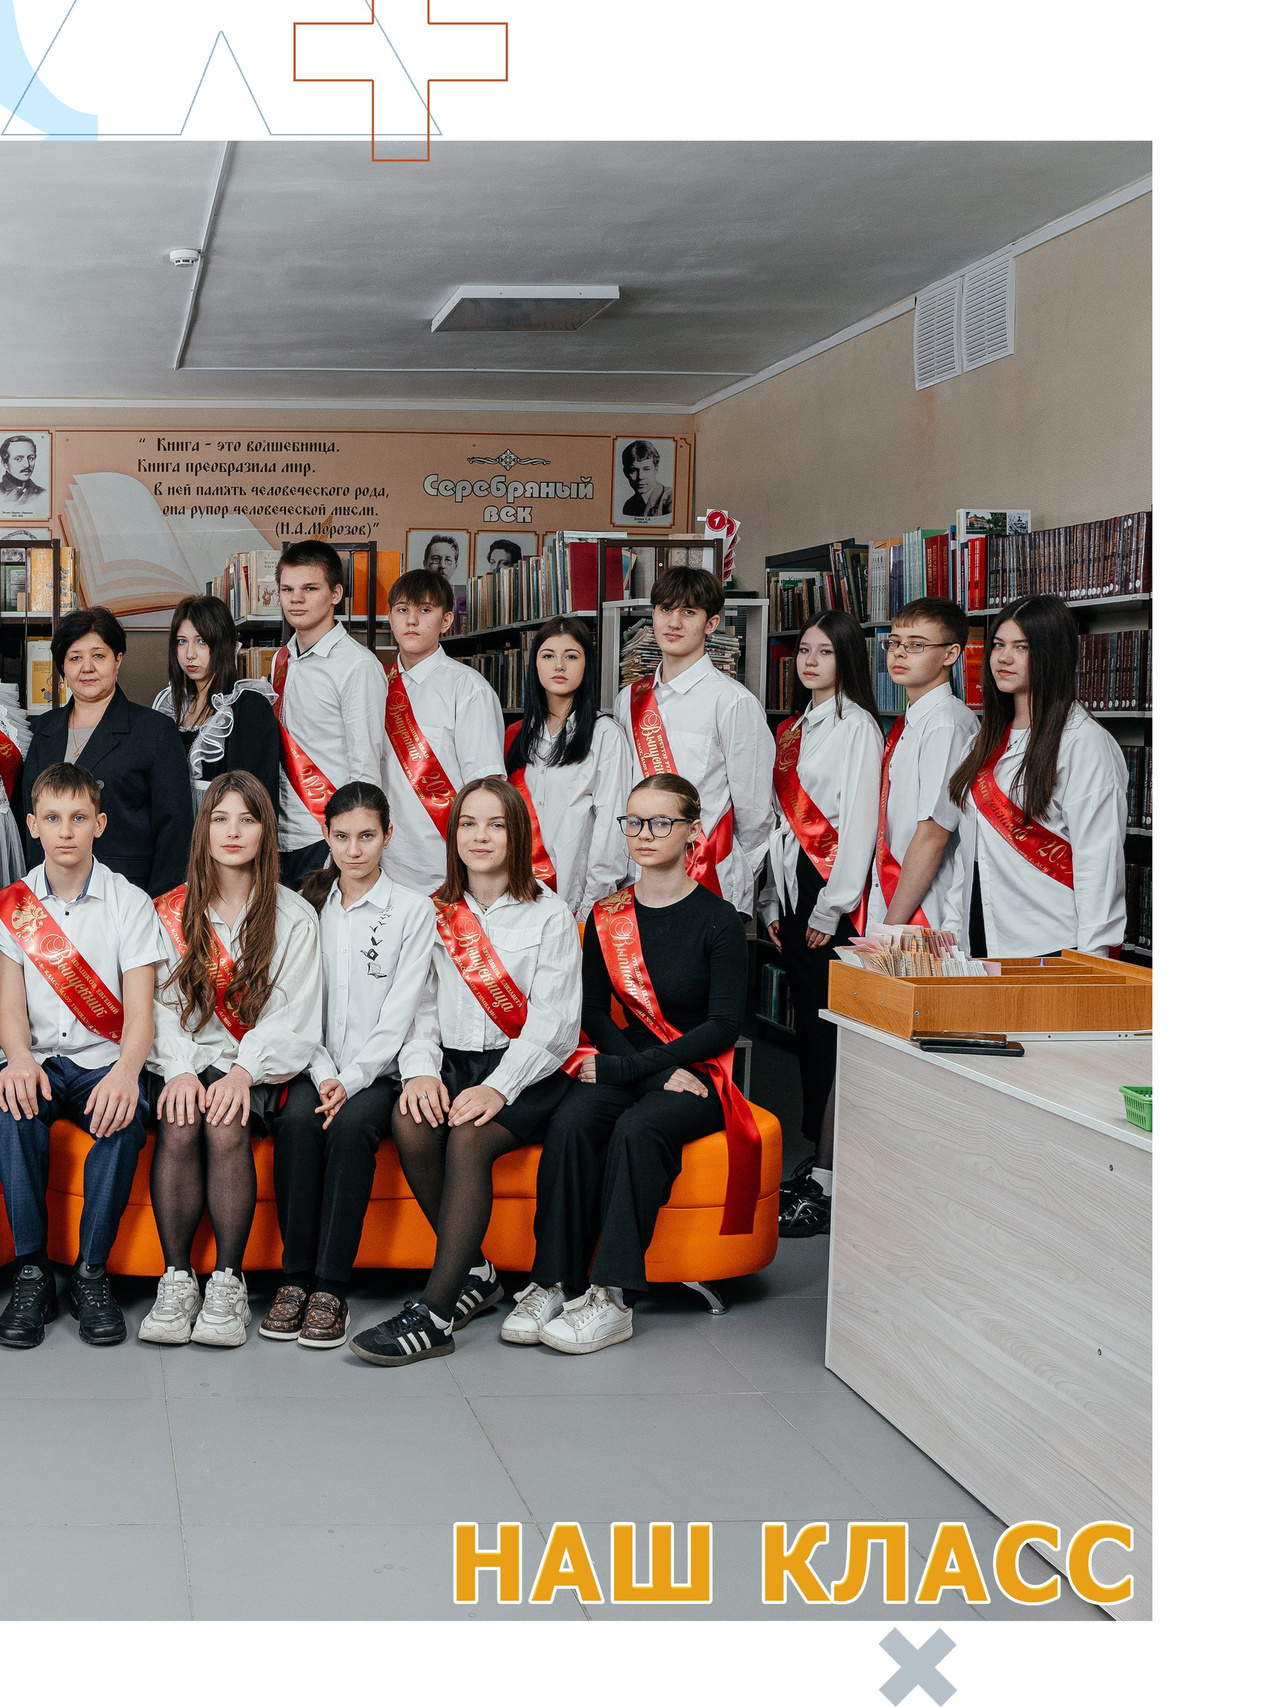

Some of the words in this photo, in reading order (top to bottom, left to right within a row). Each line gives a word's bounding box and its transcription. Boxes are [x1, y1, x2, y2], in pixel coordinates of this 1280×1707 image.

[157, 438, 200, 452] Книга
[217, 440, 241, 452] это
[247, 439, 340, 454] волшебница.
[138, 458, 180, 473] Книга
[186, 461, 276, 476] преобразила
[282, 462, 316, 476] мир.
[168, 484, 191, 495] ней
[196, 486, 247, 496] память
[251, 486, 350, 497] человеческого
[355, 486, 390, 500] рода,
[423, 474, 594, 503] Серебряный
[162, 505, 186, 516] она
[190, 505, 229, 518] рупор
[234, 503, 326, 516] человеческой
[330, 506, 378, 516] мысли.
[483, 505, 533, 523] век
[387, 690, 422, 762] Выпускник
[296, 767, 334, 802] 2025
[419, 772, 456, 807] 2025
[40, 933, 108, 1018] Выпускник
[452, 916, 514, 1013] Выпускница
[71, 958, 97, 989] ИВАШКОВ
[96, 988, 119, 1015] ЕВГЕНИЙ
[501, 979, 523, 1008] ЕЛИЗАВЕТА
